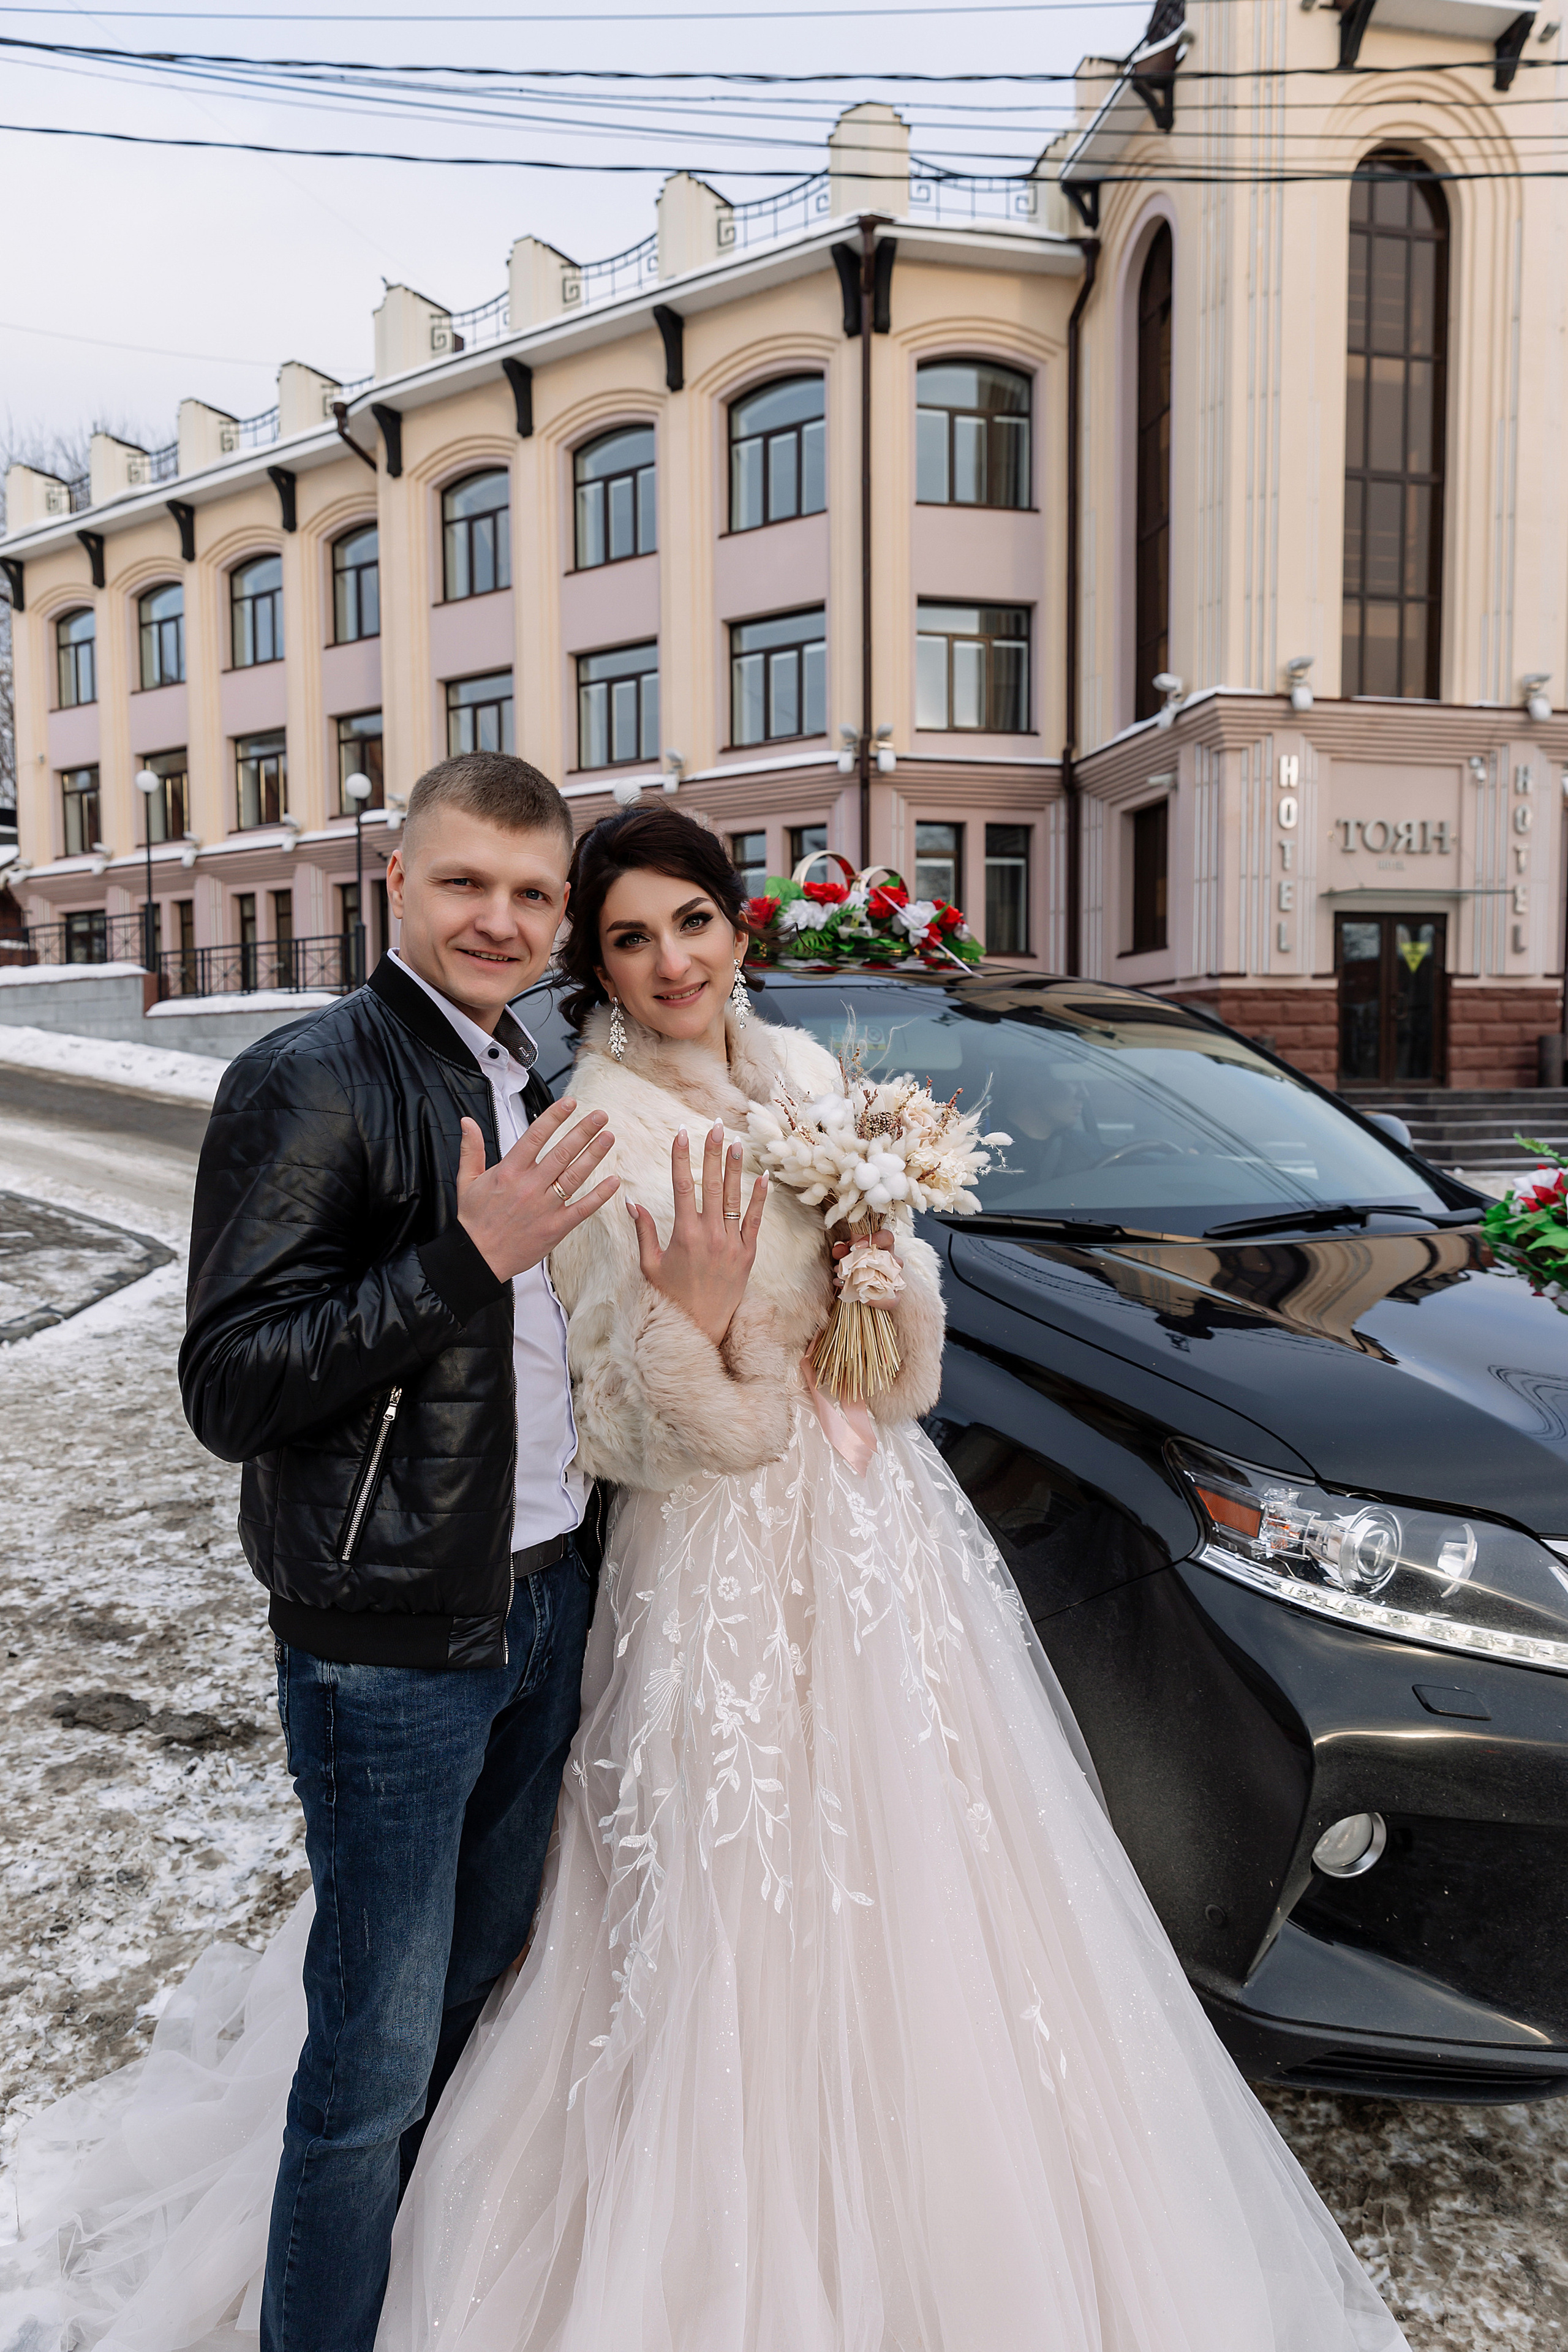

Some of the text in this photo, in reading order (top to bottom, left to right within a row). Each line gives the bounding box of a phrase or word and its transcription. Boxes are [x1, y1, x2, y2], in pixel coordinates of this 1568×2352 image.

[1278, 755, 1299, 952] HOTEL
[1336, 818, 1450, 854] ТОЯН
[1513, 764, 1532, 954] HOTEL
